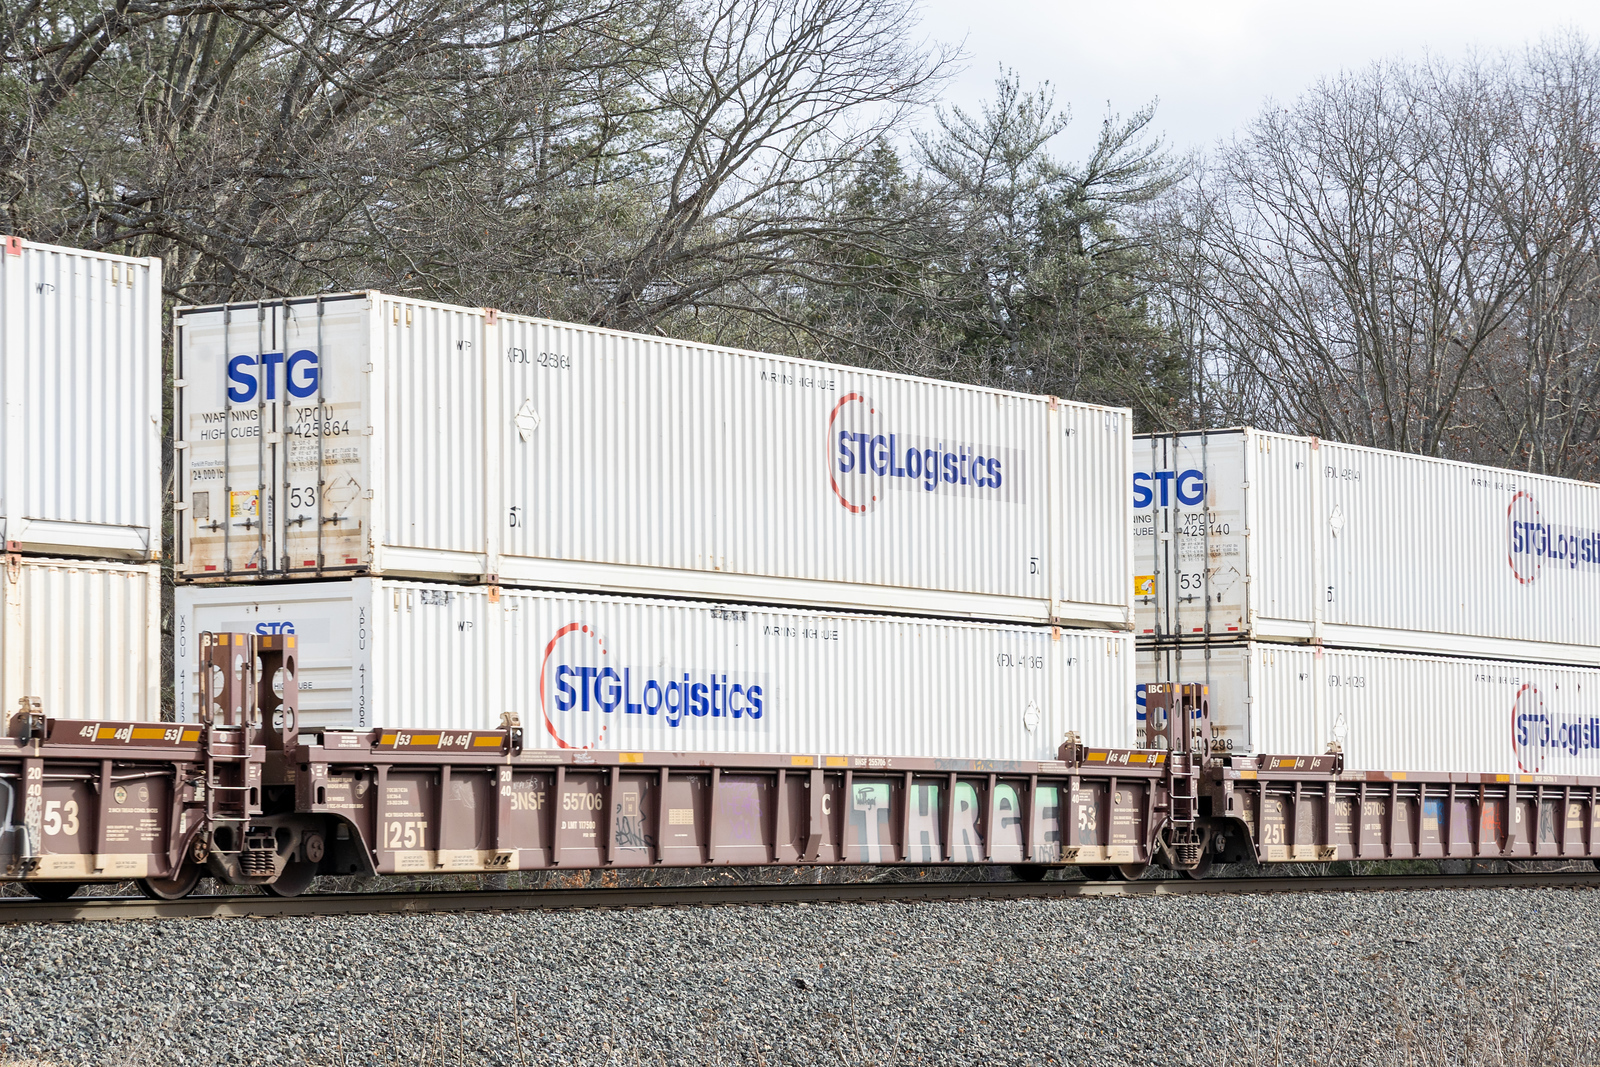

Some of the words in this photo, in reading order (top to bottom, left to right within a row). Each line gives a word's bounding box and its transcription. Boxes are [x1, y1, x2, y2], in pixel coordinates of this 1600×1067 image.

[227, 349, 322, 402] STG
[202, 410, 258, 424] WARNING
[296, 406, 334, 423] XPOU
[230, 426, 260, 438] CUBE
[294, 420, 350, 438] 425864
[1133, 470, 1208, 508] STG
[1183, 524, 1230, 537] 425140
[204, 634, 218, 646] BC
[1148, 684, 1163, 694] IBC
[79, 726, 94, 738] 45
[114, 728, 128, 740] 48
[164, 728, 178, 740] 53
[398, 734, 411, 746] 53
[442, 735, 453, 746] 48
[455, 734, 468, 746] 45
[854, 758, 868, 766] BNSF
[1110, 753, 1118, 763] 45
[1118, 754, 1127, 763] 48
[1147, 755, 1155, 763] 53
[1272, 759, 1280, 768] 53
[1313, 759, 1320, 767] 45
[28, 767, 42, 780] 20
[500, 770, 512, 782] 20
[28, 784, 42, 796] 40
[500, 785, 512, 797] 40
[1072, 782, 1080, 792] 20
[563, 792, 602, 810] 55706
[822, 794, 831, 815] C
[1072, 794, 1080, 804] 40
[43, 800, 79, 836] 53
[1078, 804, 1096, 831] 53
[561, 821, 567, 830] D
[1264, 824, 1286, 844] 25T
